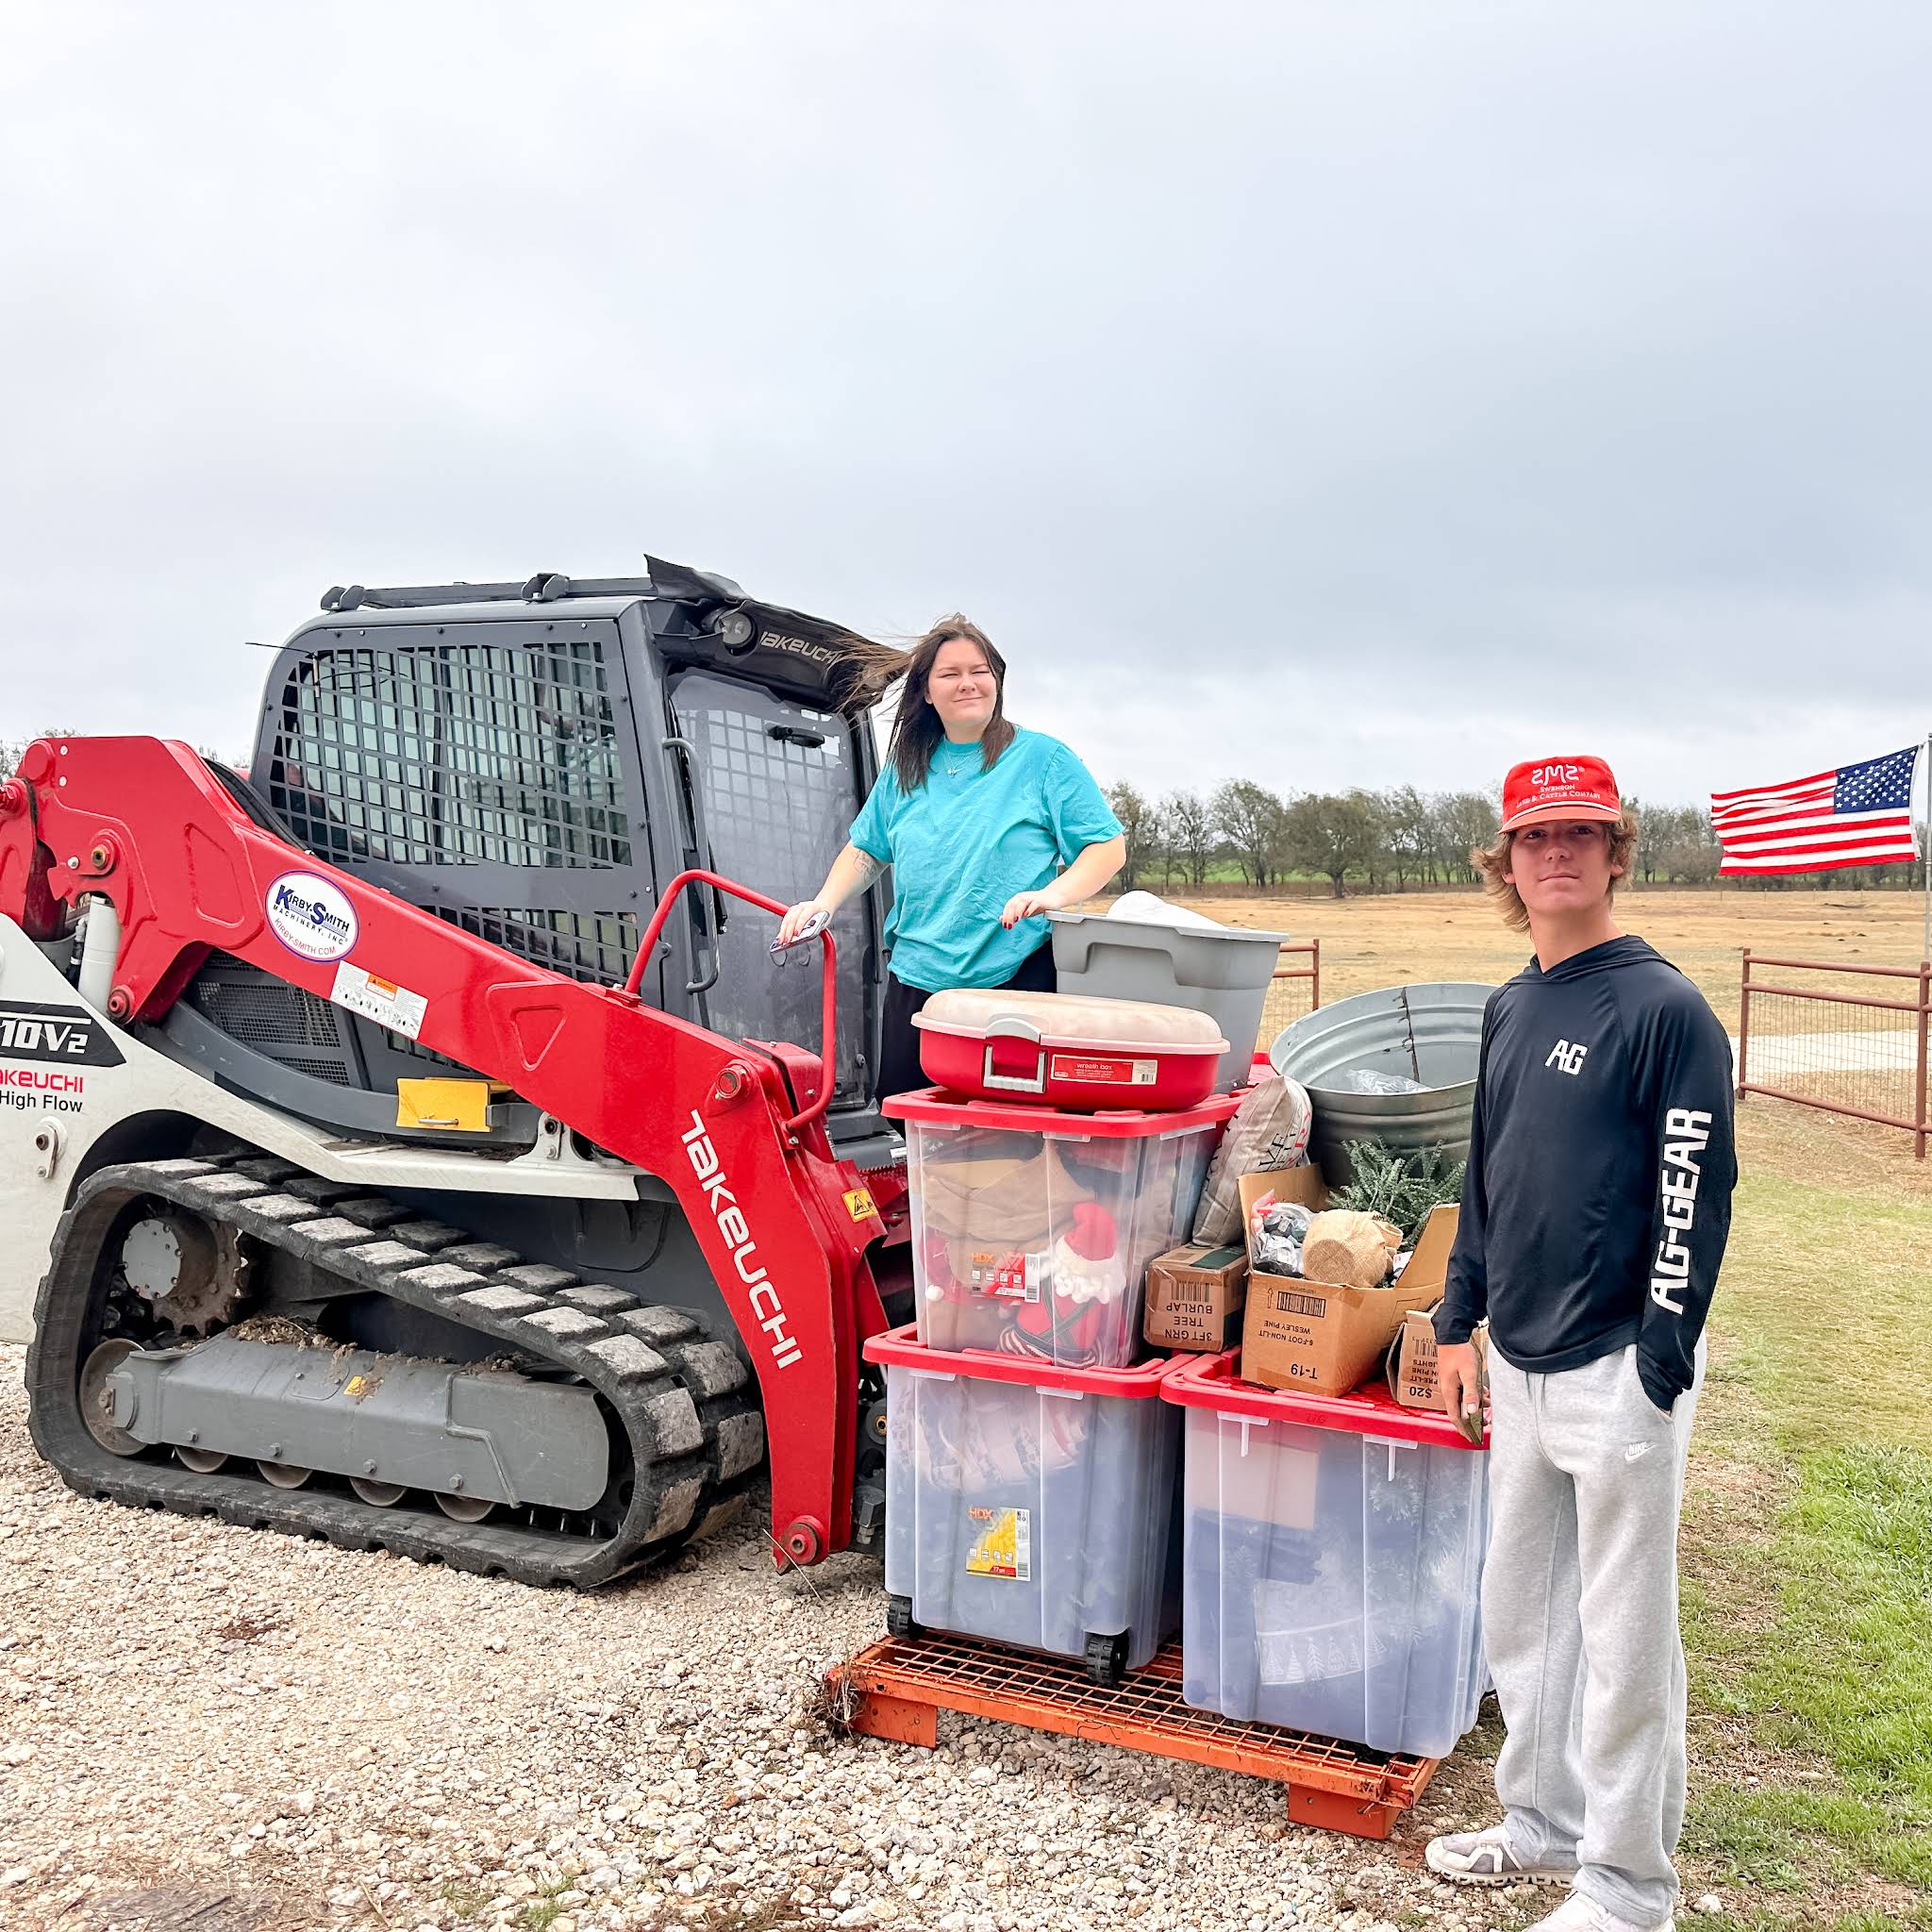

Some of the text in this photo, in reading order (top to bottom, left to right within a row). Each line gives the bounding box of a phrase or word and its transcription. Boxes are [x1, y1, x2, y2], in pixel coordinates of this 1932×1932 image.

[1545, 1039, 1589, 1075] AG
[0, 1090, 83, 1113] High Flow
[1651, 1108, 1712, 1315] AG-GEAR
[1166, 1302, 1213, 1314] BURLAP
[1174, 1316, 1204, 1327] TREE
[1165, 1328, 1212, 1341] 3FT GRN
[1258, 1329, 1287, 1341] NON-LIT
[1281, 1323, 1311, 1335] WESLEY
[1291, 1363, 1318, 1379] T-19
[1412, 1367, 1429, 1375] PINE
[1409, 1386, 1432, 1399] $20
